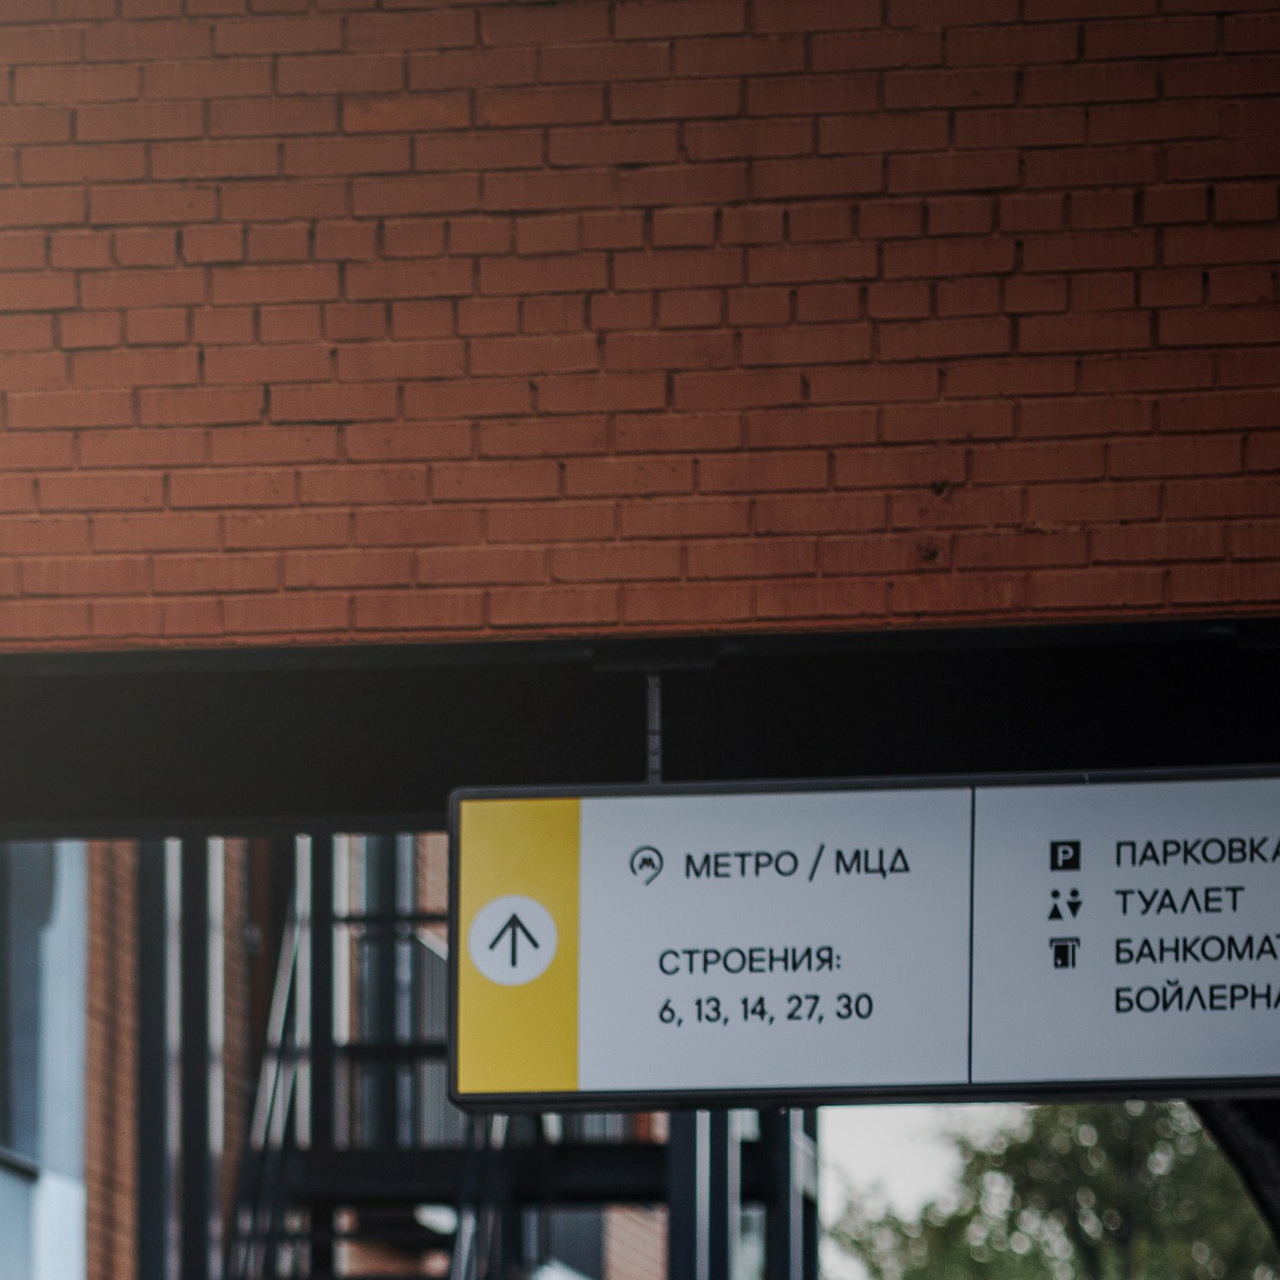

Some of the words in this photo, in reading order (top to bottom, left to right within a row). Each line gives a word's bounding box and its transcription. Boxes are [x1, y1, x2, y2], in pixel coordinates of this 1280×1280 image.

[685, 850, 799, 879] МЕТРО
[808, 843, 826, 883] /
[835, 847, 911, 880] МЦД
[1113, 885, 1247, 917] ТУАЛЕТ
[658, 945, 842, 977] СТРОЕНИЯ:
[1114, 932, 1280, 966] БАНКОМА
[658, 999, 683, 1027] 6,
[695, 996, 729, 1026] 13,
[741, 995, 775, 1025] 14,
[786, 993, 824, 1026] 27,
[835, 992, 874, 1020] 30
[1114, 978, 1280, 1014] БОЙЛЕРН
